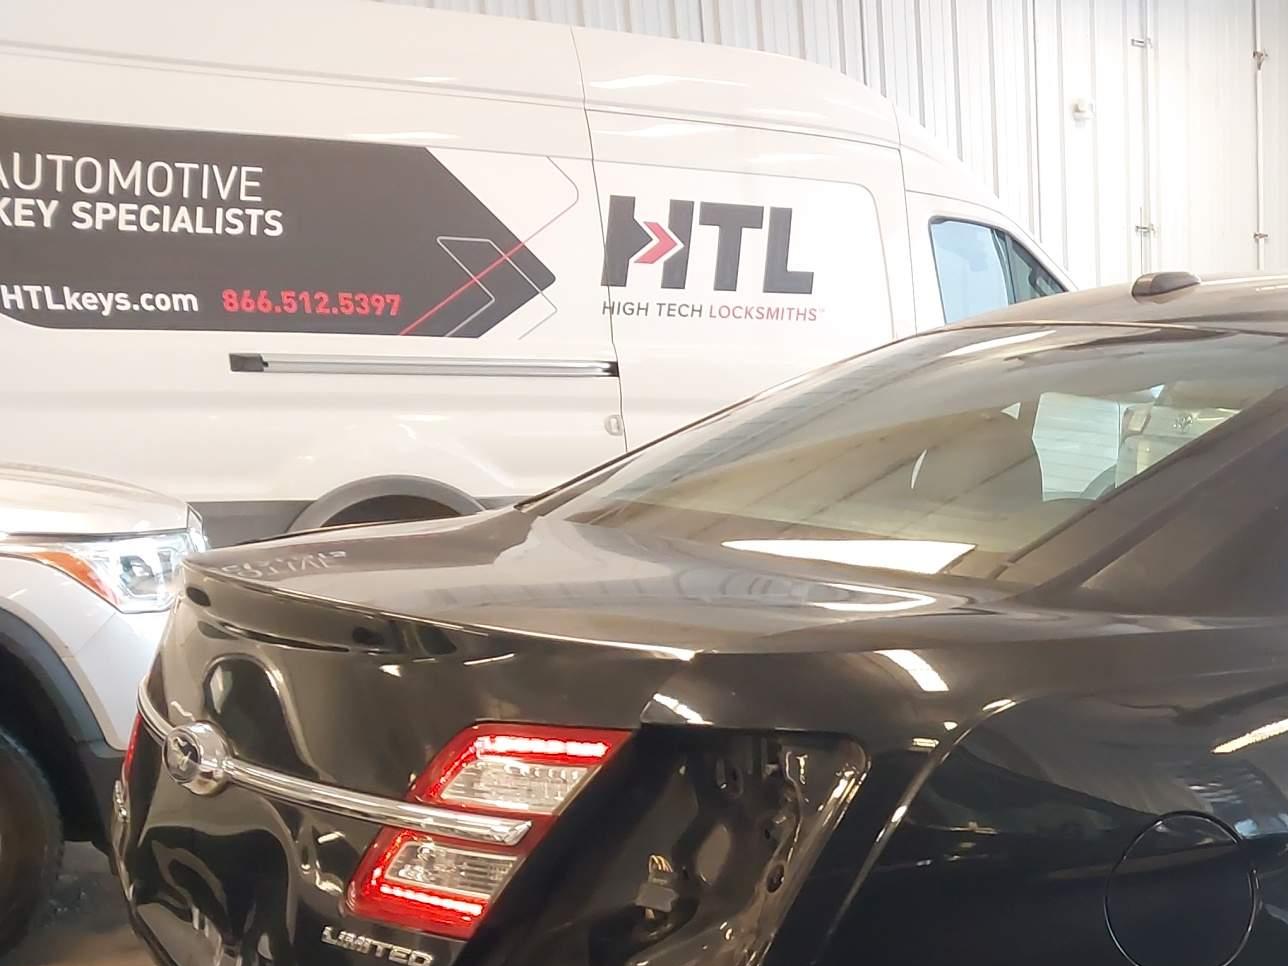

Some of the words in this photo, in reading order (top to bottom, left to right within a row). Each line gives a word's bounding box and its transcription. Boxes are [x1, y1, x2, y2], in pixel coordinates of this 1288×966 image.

[71, 200, 284, 237] SPECIALISTS
[601, 194, 815, 295] HTL
[0, 284, 199, 316] HTLkeys.com
[222, 288, 401, 316] 866.512.5397
[601, 300, 649, 317] HIGH
[656, 302, 703, 318] TECH
[709, 305, 817, 322] LOCKSMITHS
